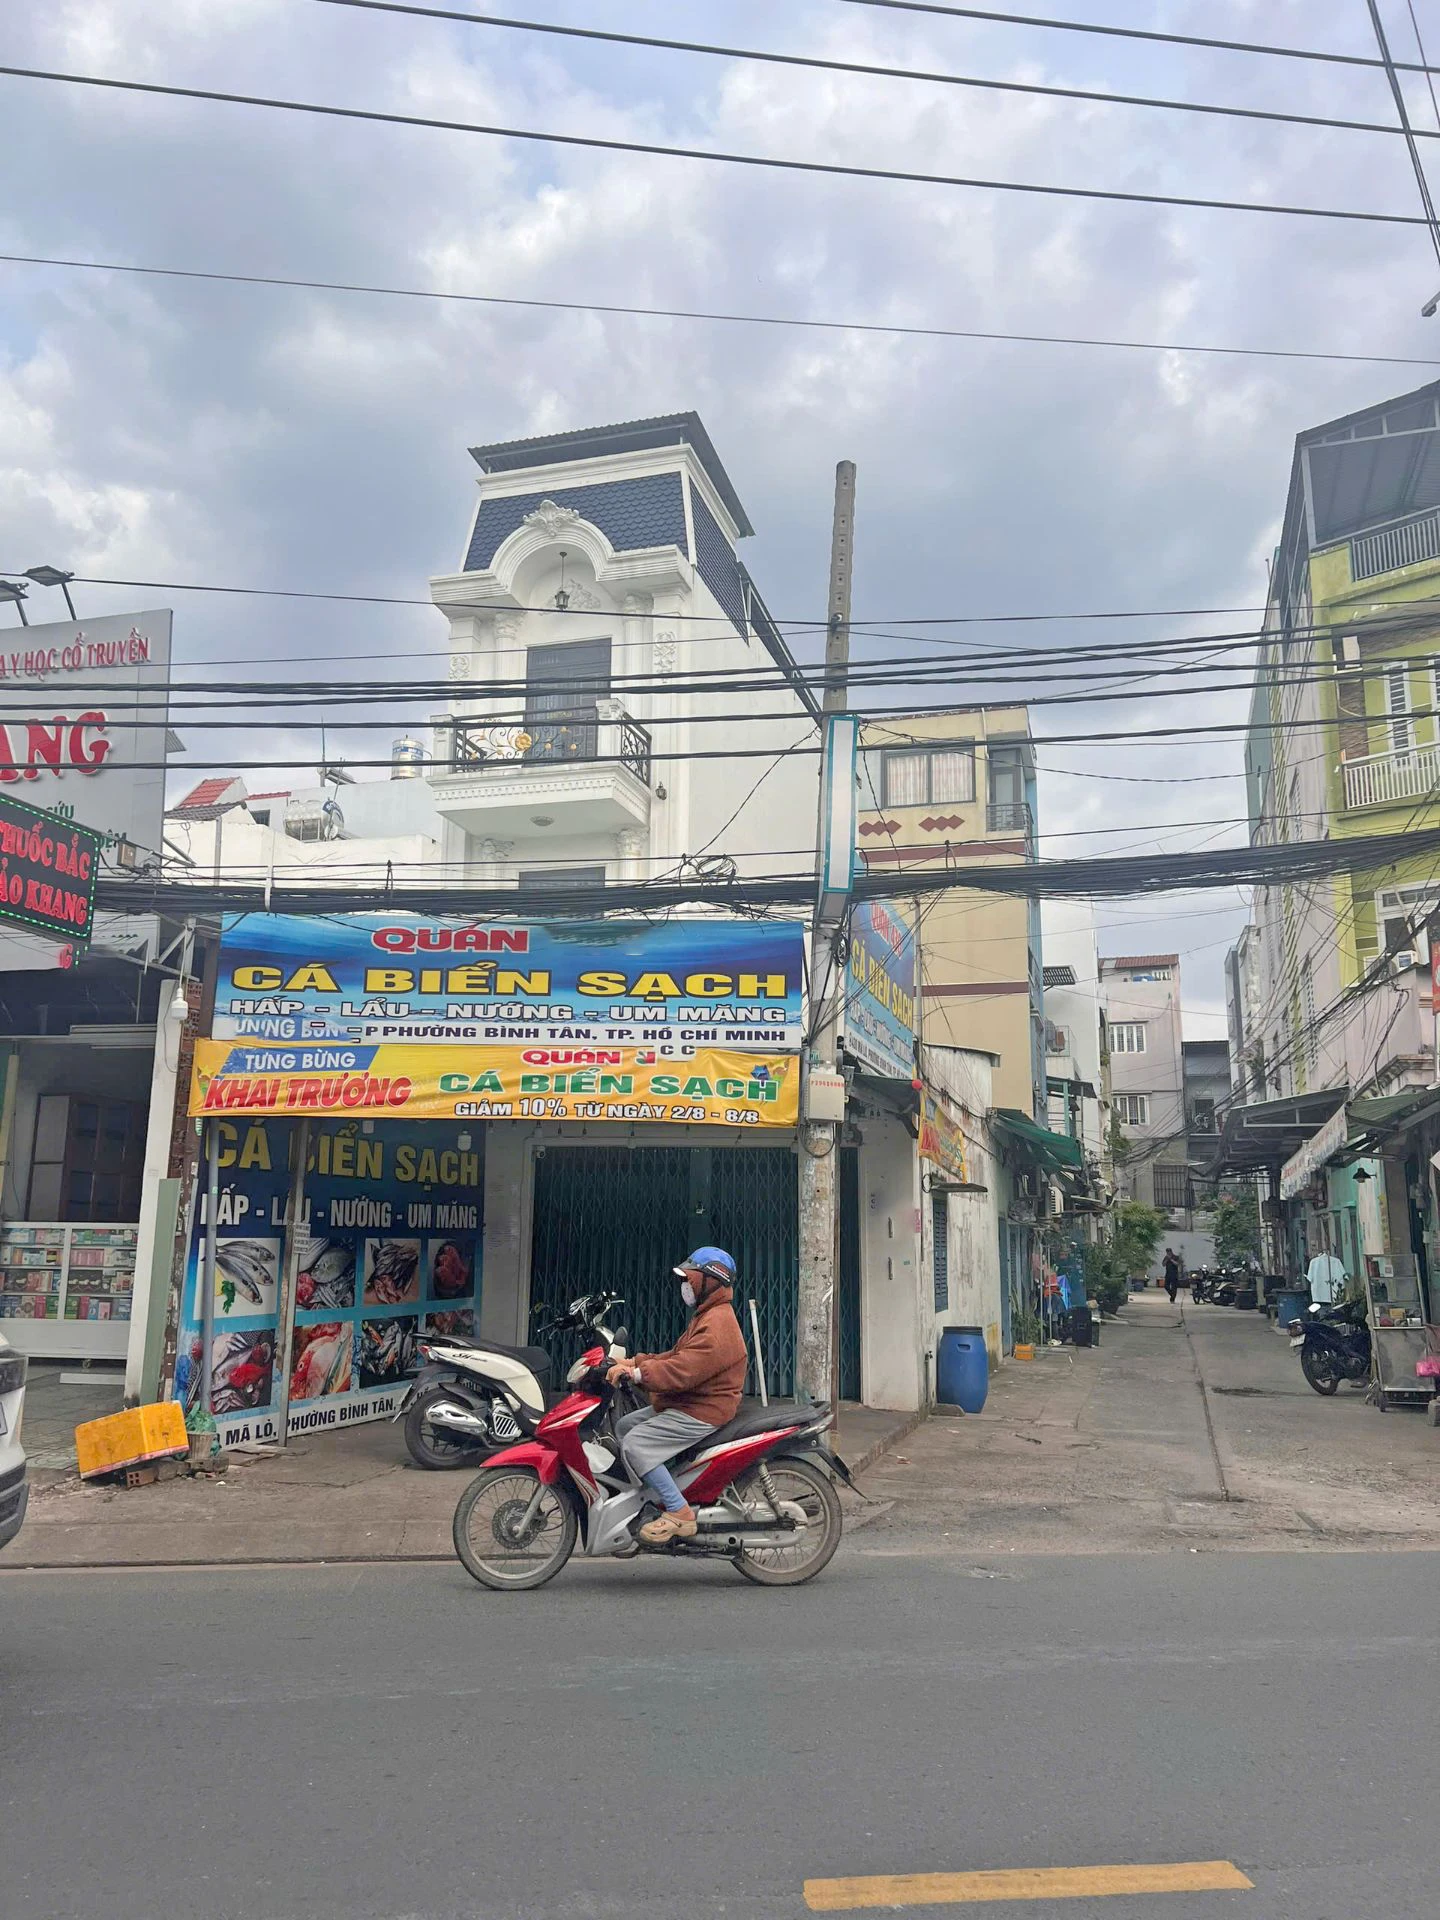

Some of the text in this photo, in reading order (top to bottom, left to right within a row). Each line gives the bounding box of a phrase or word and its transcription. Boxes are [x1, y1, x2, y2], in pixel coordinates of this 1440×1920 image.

[11, 652, 20, 677] Y
[25, 646, 58, 681] HỌC
[62, 632, 85, 670] CỔ
[87, 627, 149, 667] TRUYỀN
[25, 878, 88, 925] KHANG
[371, 923, 530, 954] QUÁN
[851, 938, 866, 983] CÁ
[231, 960, 788, 1003] CÁ BIỂN SẠCH
[230, 995, 305, 1015] HẤP
[446, 1001, 574, 1020] NƯỚNG
[609, 1005, 668, 1022] UM
[677, 1004, 787, 1022] MĂNG
[484, 1026, 540, 1038] BÌNH
[547, 1027, 598, 1041] TÂN,
[605, 1029, 635, 1040] TP.
[680, 1028, 718, 1041] CHÍ
[725, 1030, 785, 1041] MINH
[302, 1048, 356, 1069] BỪNG
[521, 1047, 623, 1066] QUÁN
[202, 1071, 413, 1110] KHAI TRƯƠNG
[438, 1066, 779, 1101] CÁ BIỂN SẠCH
[454, 1098, 513, 1116] GIẢM
[518, 1097, 568, 1118] 10%
[574, 1100, 604, 1118] TỪ
[606, 1101, 667, 1119] NGÀY
[671, 1105, 706, 1121] 2/8
[724, 1108, 760, 1124] 8/8
[394, 1145, 479, 1192] SẠCH
[330, 1195, 393, 1229] NƯỚNG
[407, 1202, 432, 1229] UM
[436, 1200, 478, 1229] MĂNG
[225, 1423, 251, 1446] MÃ
[339, 1400, 369, 1421] BÌNH
